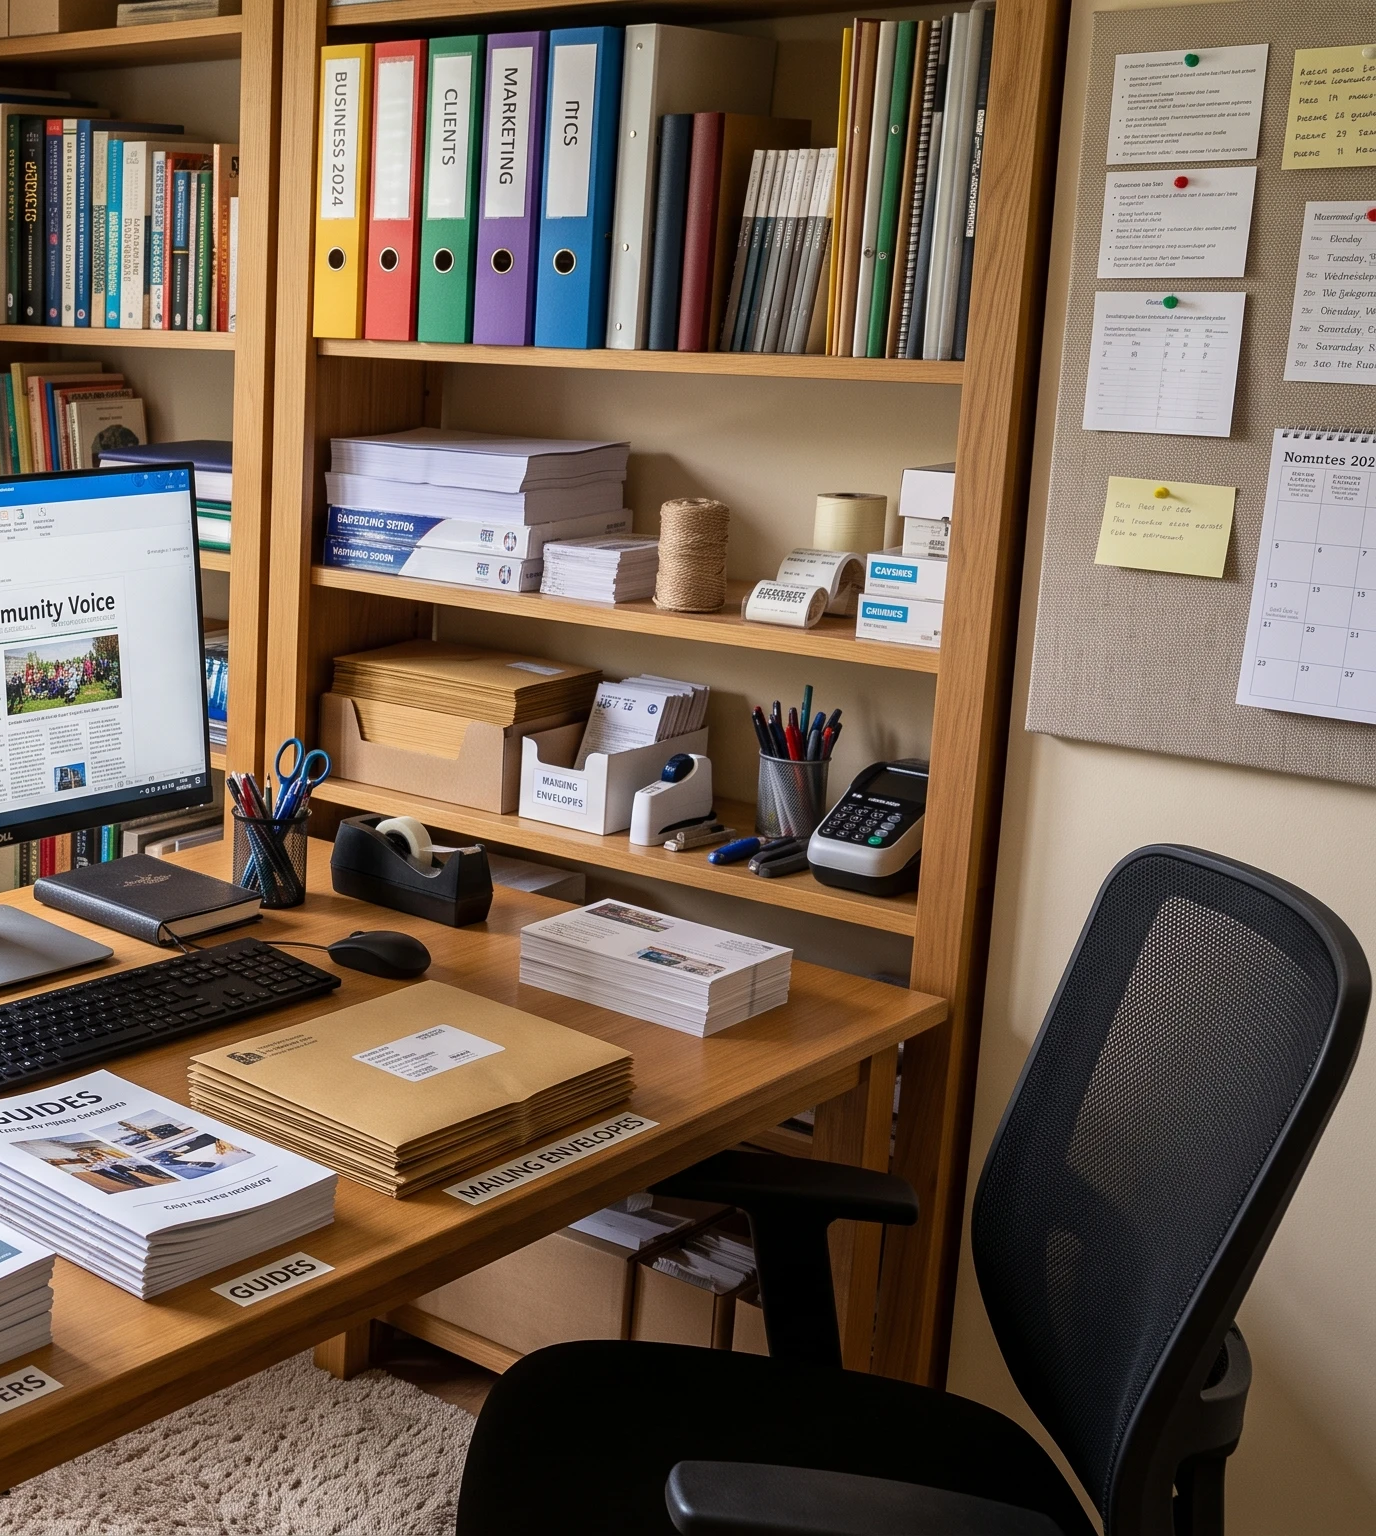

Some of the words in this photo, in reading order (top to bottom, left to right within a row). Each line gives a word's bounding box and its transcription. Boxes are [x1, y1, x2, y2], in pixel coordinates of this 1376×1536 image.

[332, 71, 348, 158] BUSINESS
[442, 88, 458, 166] CLIENTS
[499, 67, 518, 185] MARKETING
[331, 163, 344, 207] 2024
[67, 592, 116, 616] Voice
[458, 1159, 544, 1200] MAILING
[542, 1115, 645, 1166] ENVELOPES
[229, 1258, 317, 1300] GUIDES
